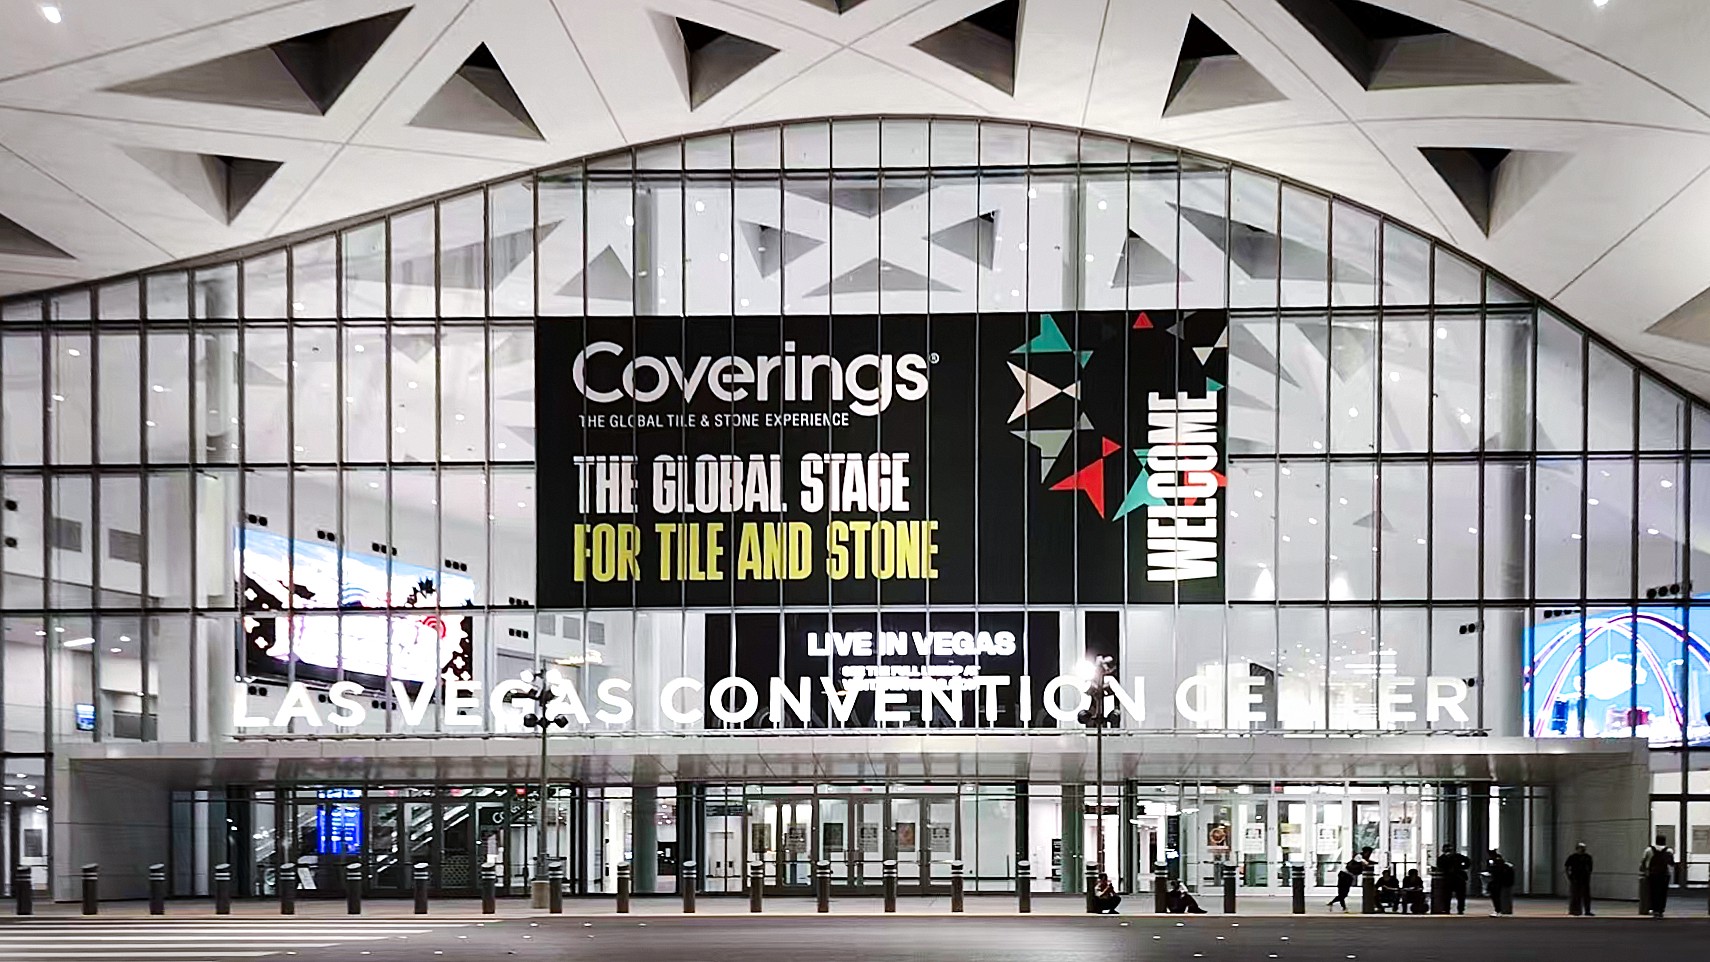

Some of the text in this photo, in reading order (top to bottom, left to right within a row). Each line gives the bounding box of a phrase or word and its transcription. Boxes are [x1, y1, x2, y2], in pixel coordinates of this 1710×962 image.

[579, 412, 849, 428] THE GLOBAL TILE & STONE EXPERIENCE
[573, 452, 910, 514] THE GLOBAL STAGE
[1147, 391, 1218, 581] WELCOME
[573, 520, 939, 582] FOR TILE AND STONE
[807, 630, 1017, 657] LIVE IN VEGAS
[233, 674, 1471, 728] LAS VEGAS CONVENTION CEER
